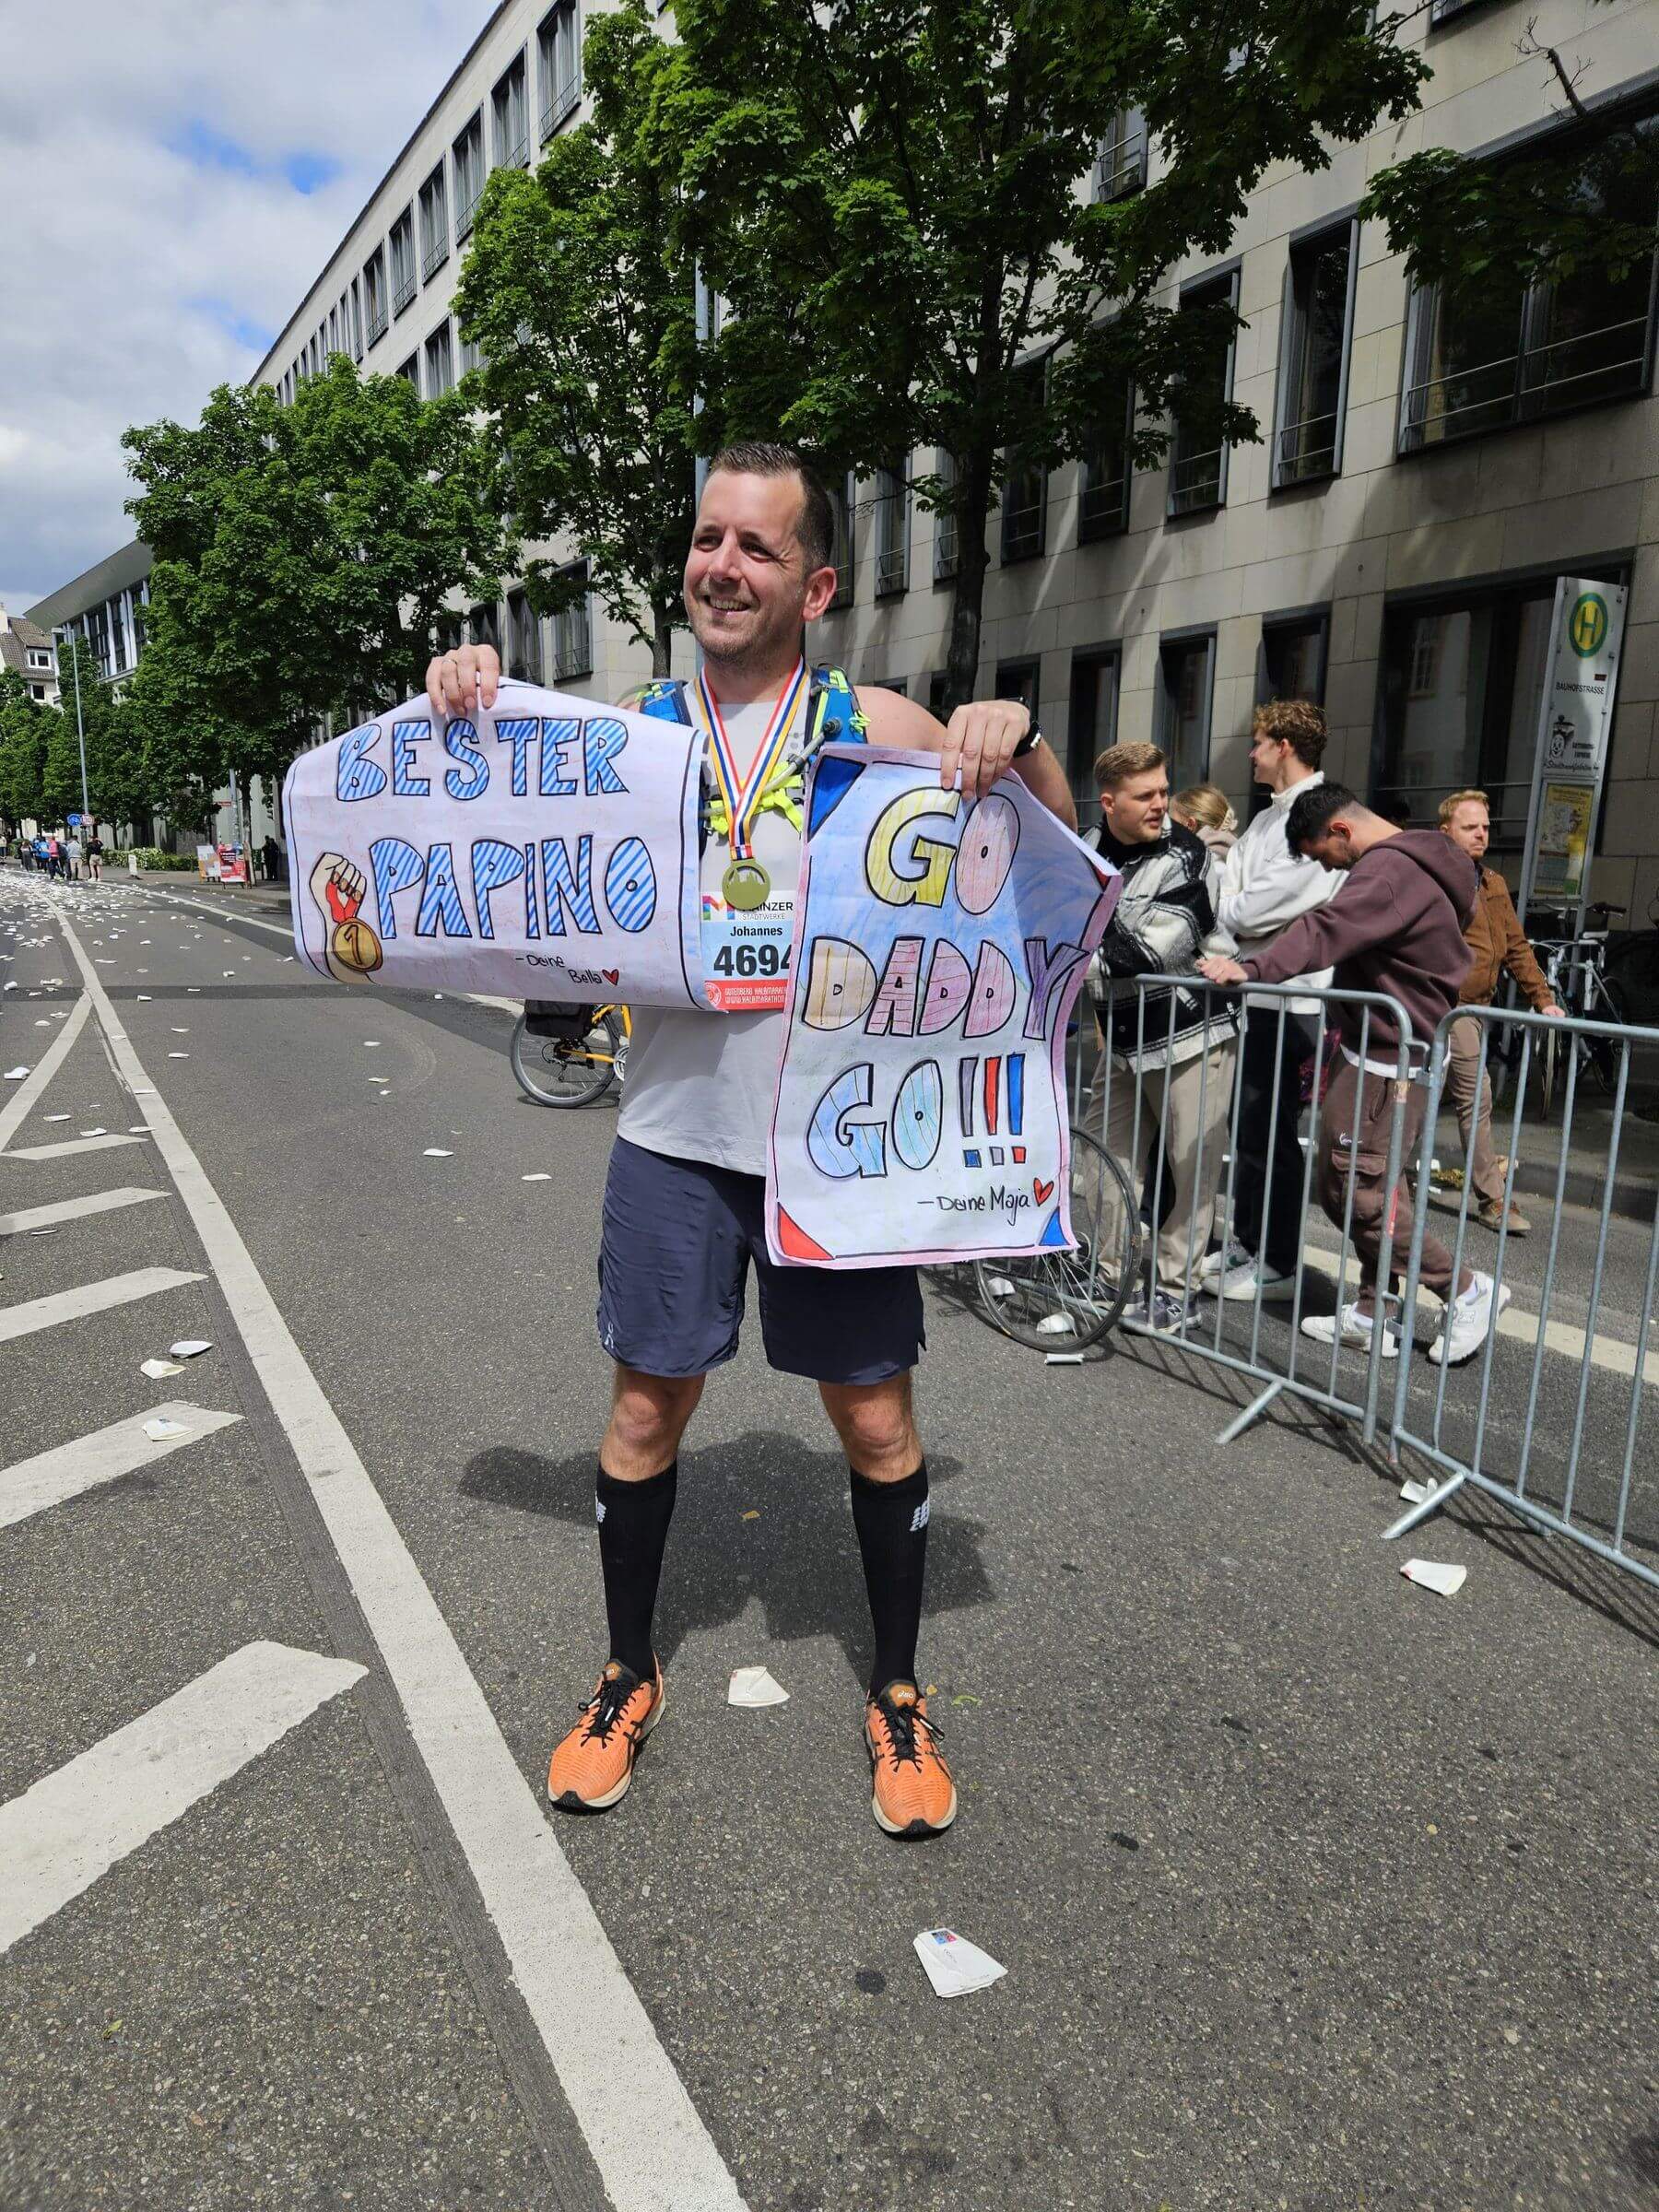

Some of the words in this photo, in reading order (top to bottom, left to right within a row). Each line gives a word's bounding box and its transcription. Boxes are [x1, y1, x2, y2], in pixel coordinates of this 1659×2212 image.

[1556, 682, 1605, 695] BAUHOFSTRASSE
[336, 718, 629, 802] BESTER
[865, 786, 1021, 915] GO
[369, 834, 657, 940] PAPINO
[743, 901, 794, 912] INZER
[730, 926, 783, 936] Johannes
[568, 969, 603, 984] Bella
[802, 935, 1088, 1041] DADDY
[806, 1053, 1027, 1179] GO!!!
[990, 1184, 1030, 1227] Maja
